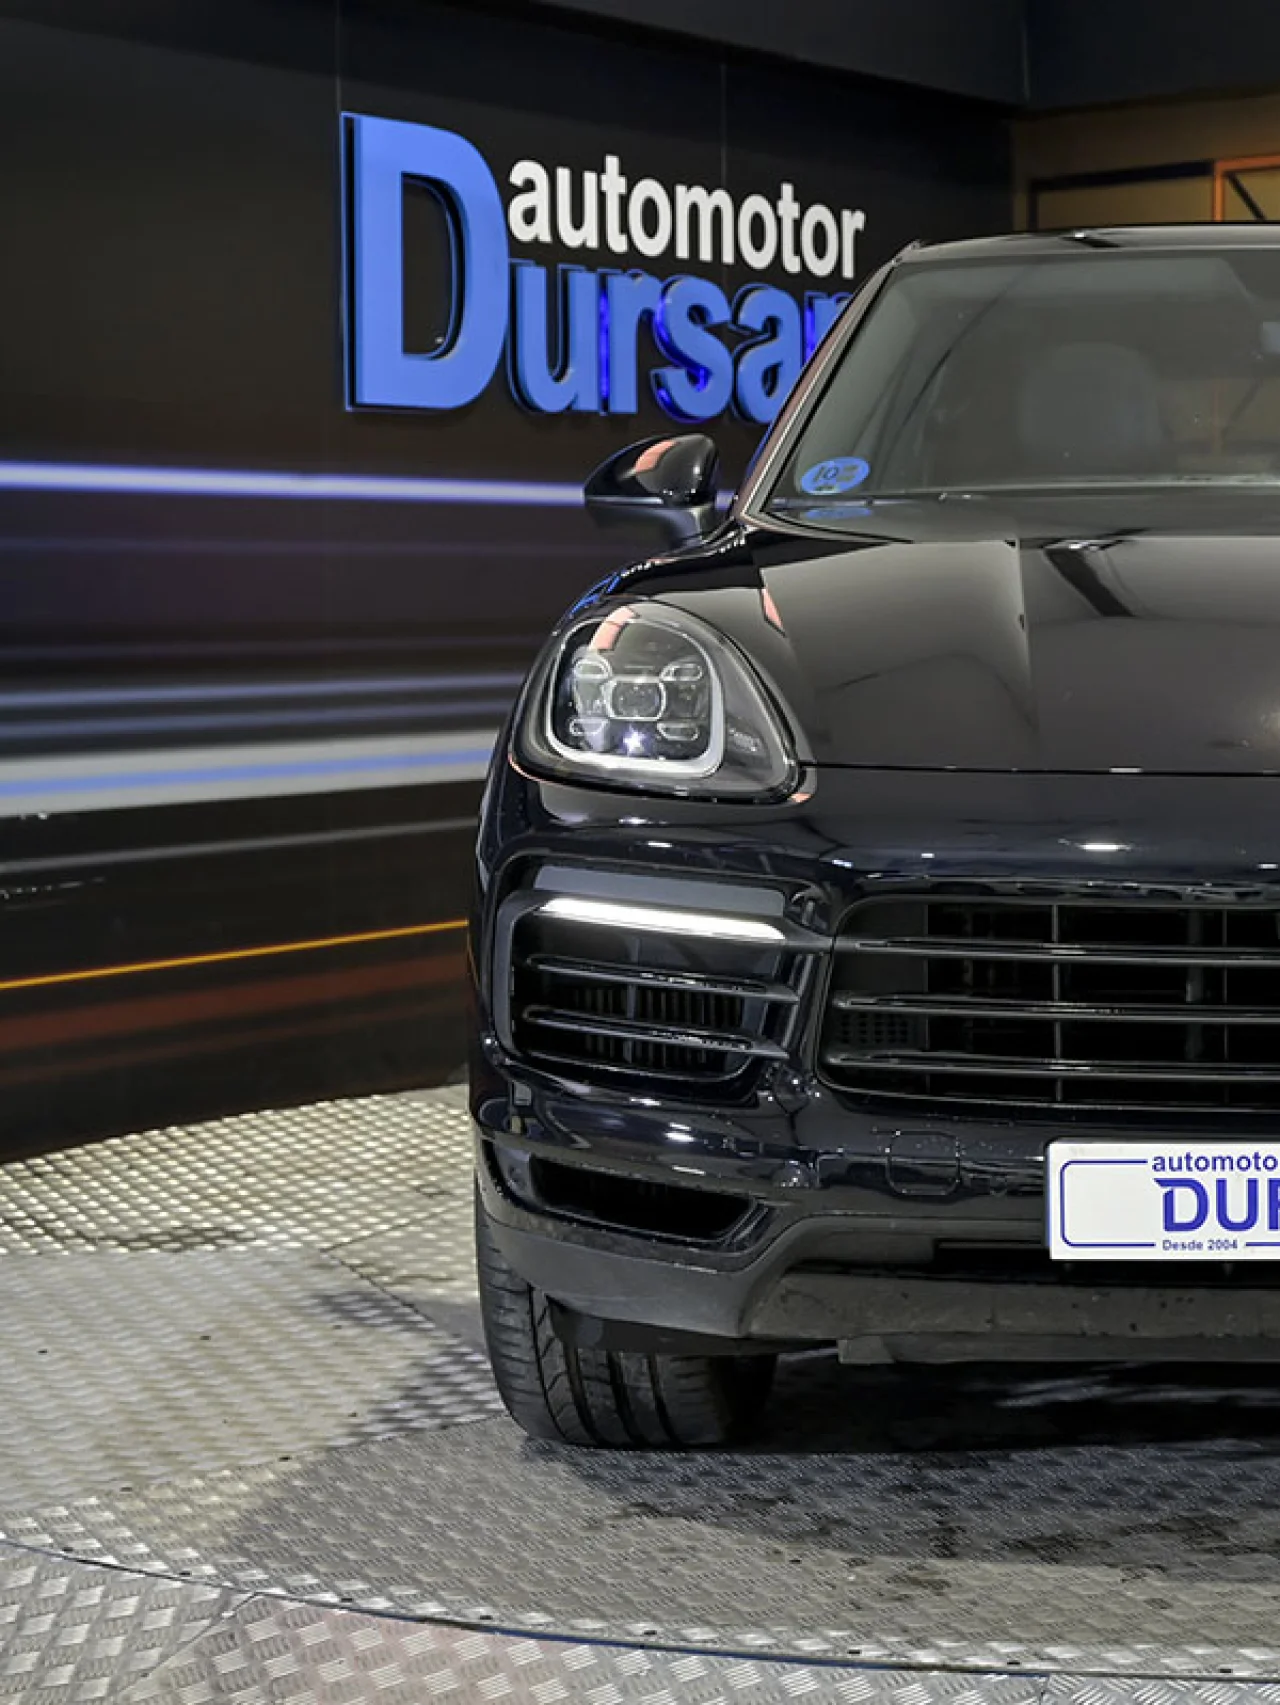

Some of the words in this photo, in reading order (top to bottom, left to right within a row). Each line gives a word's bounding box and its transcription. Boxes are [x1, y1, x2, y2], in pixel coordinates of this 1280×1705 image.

[508, 154, 865, 279] automotor
[1162, 1239, 1204, 1251] Desde
[1207, 1239, 1238, 1251] 2004
